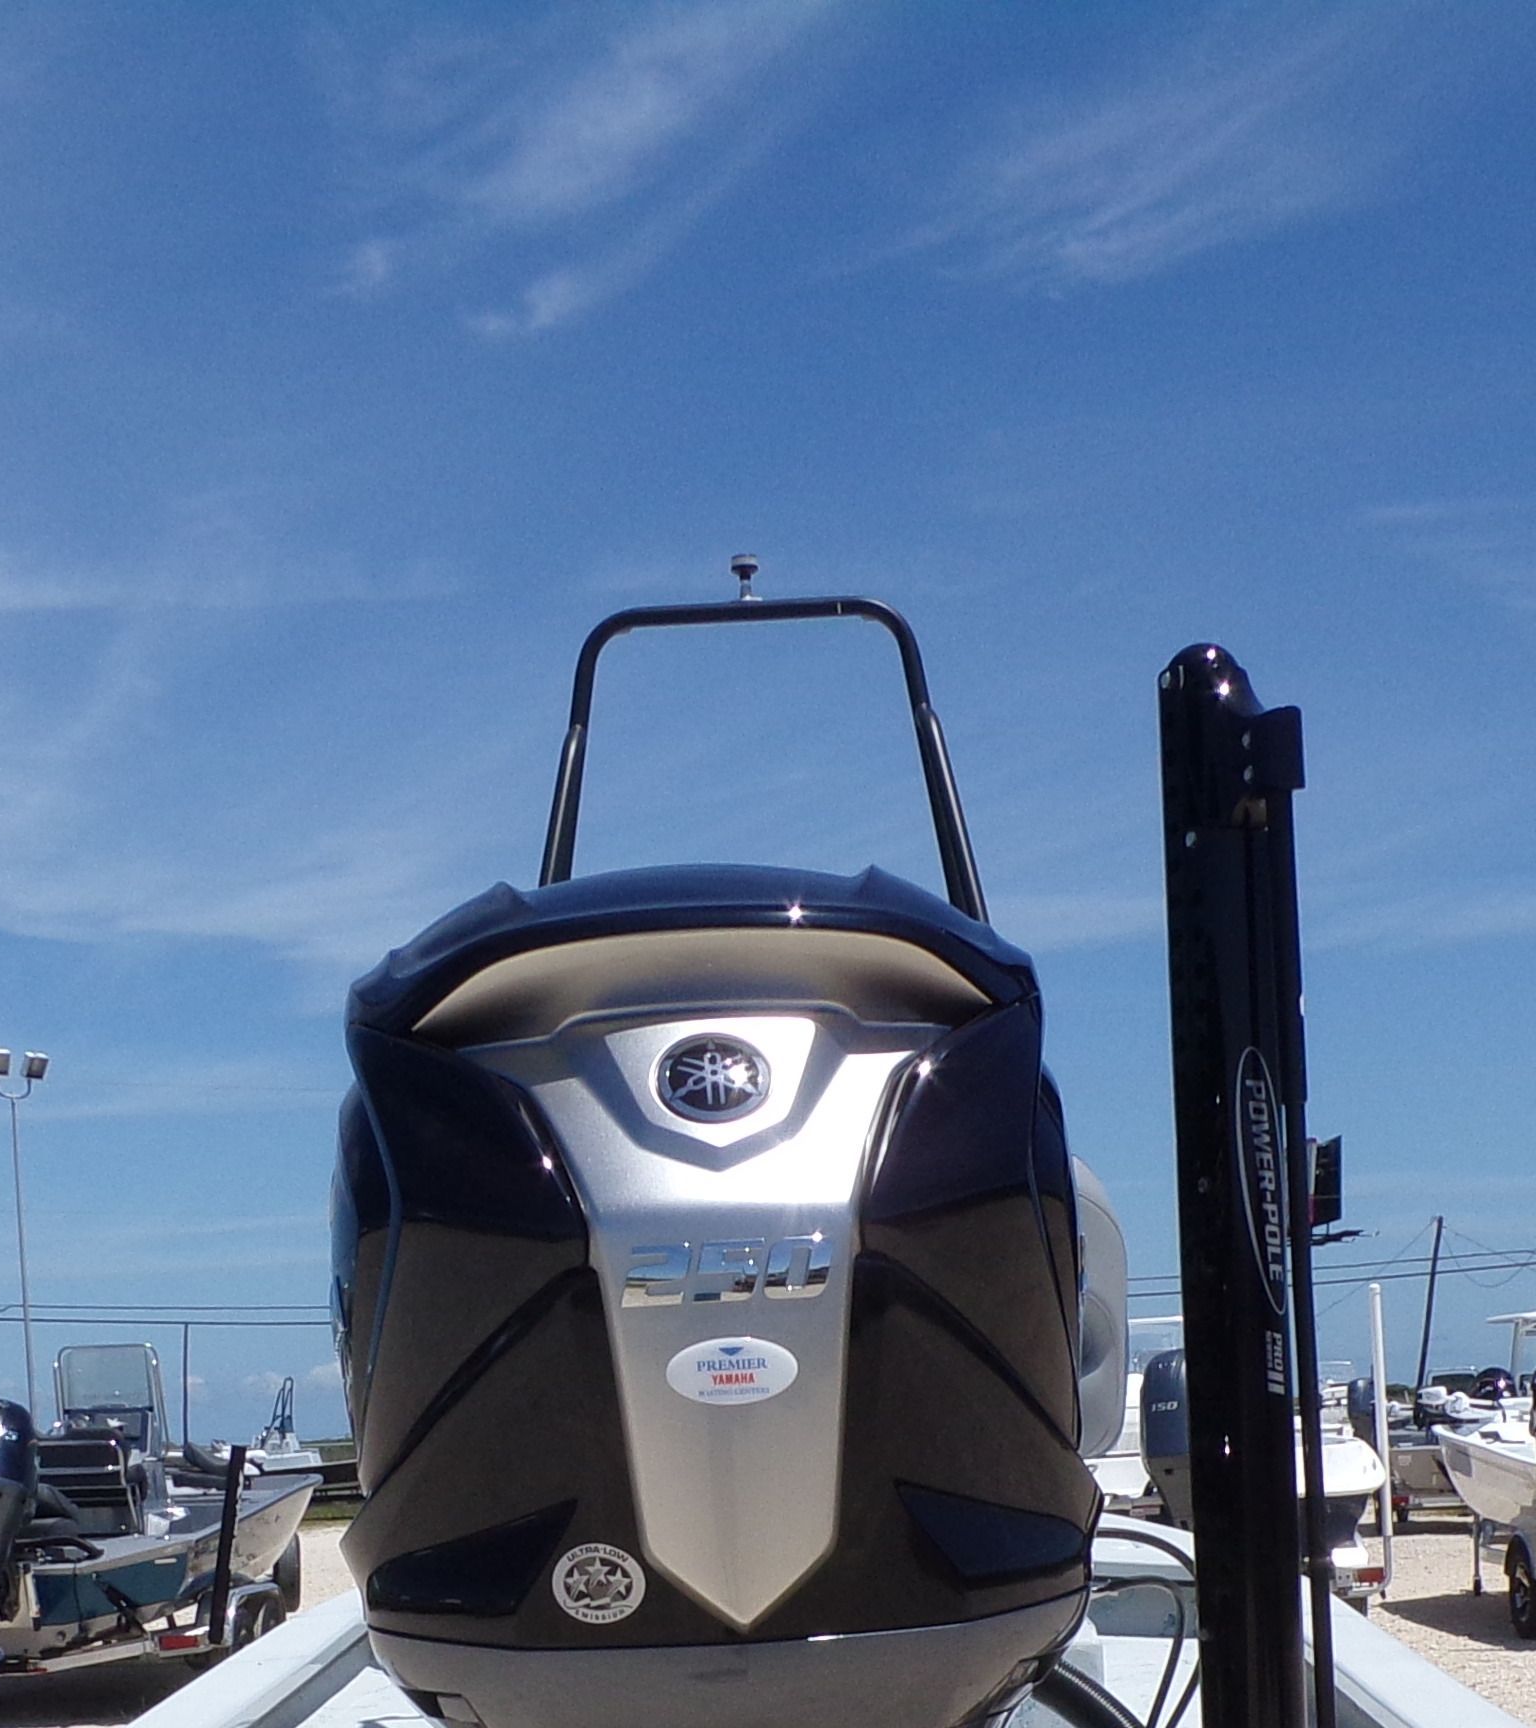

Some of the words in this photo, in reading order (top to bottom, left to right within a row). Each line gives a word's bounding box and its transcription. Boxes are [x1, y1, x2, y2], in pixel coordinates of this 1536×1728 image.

[1245, 1079, 1284, 1282] POWER-POLE
[621, 1236, 833, 1308] 250
[696, 1357, 768, 1372] PREMIER
[1272, 1331, 1284, 1371] PRO
[712, 1372, 755, 1385] YAMAHA
[1152, 1401, 1179, 1412] 150
